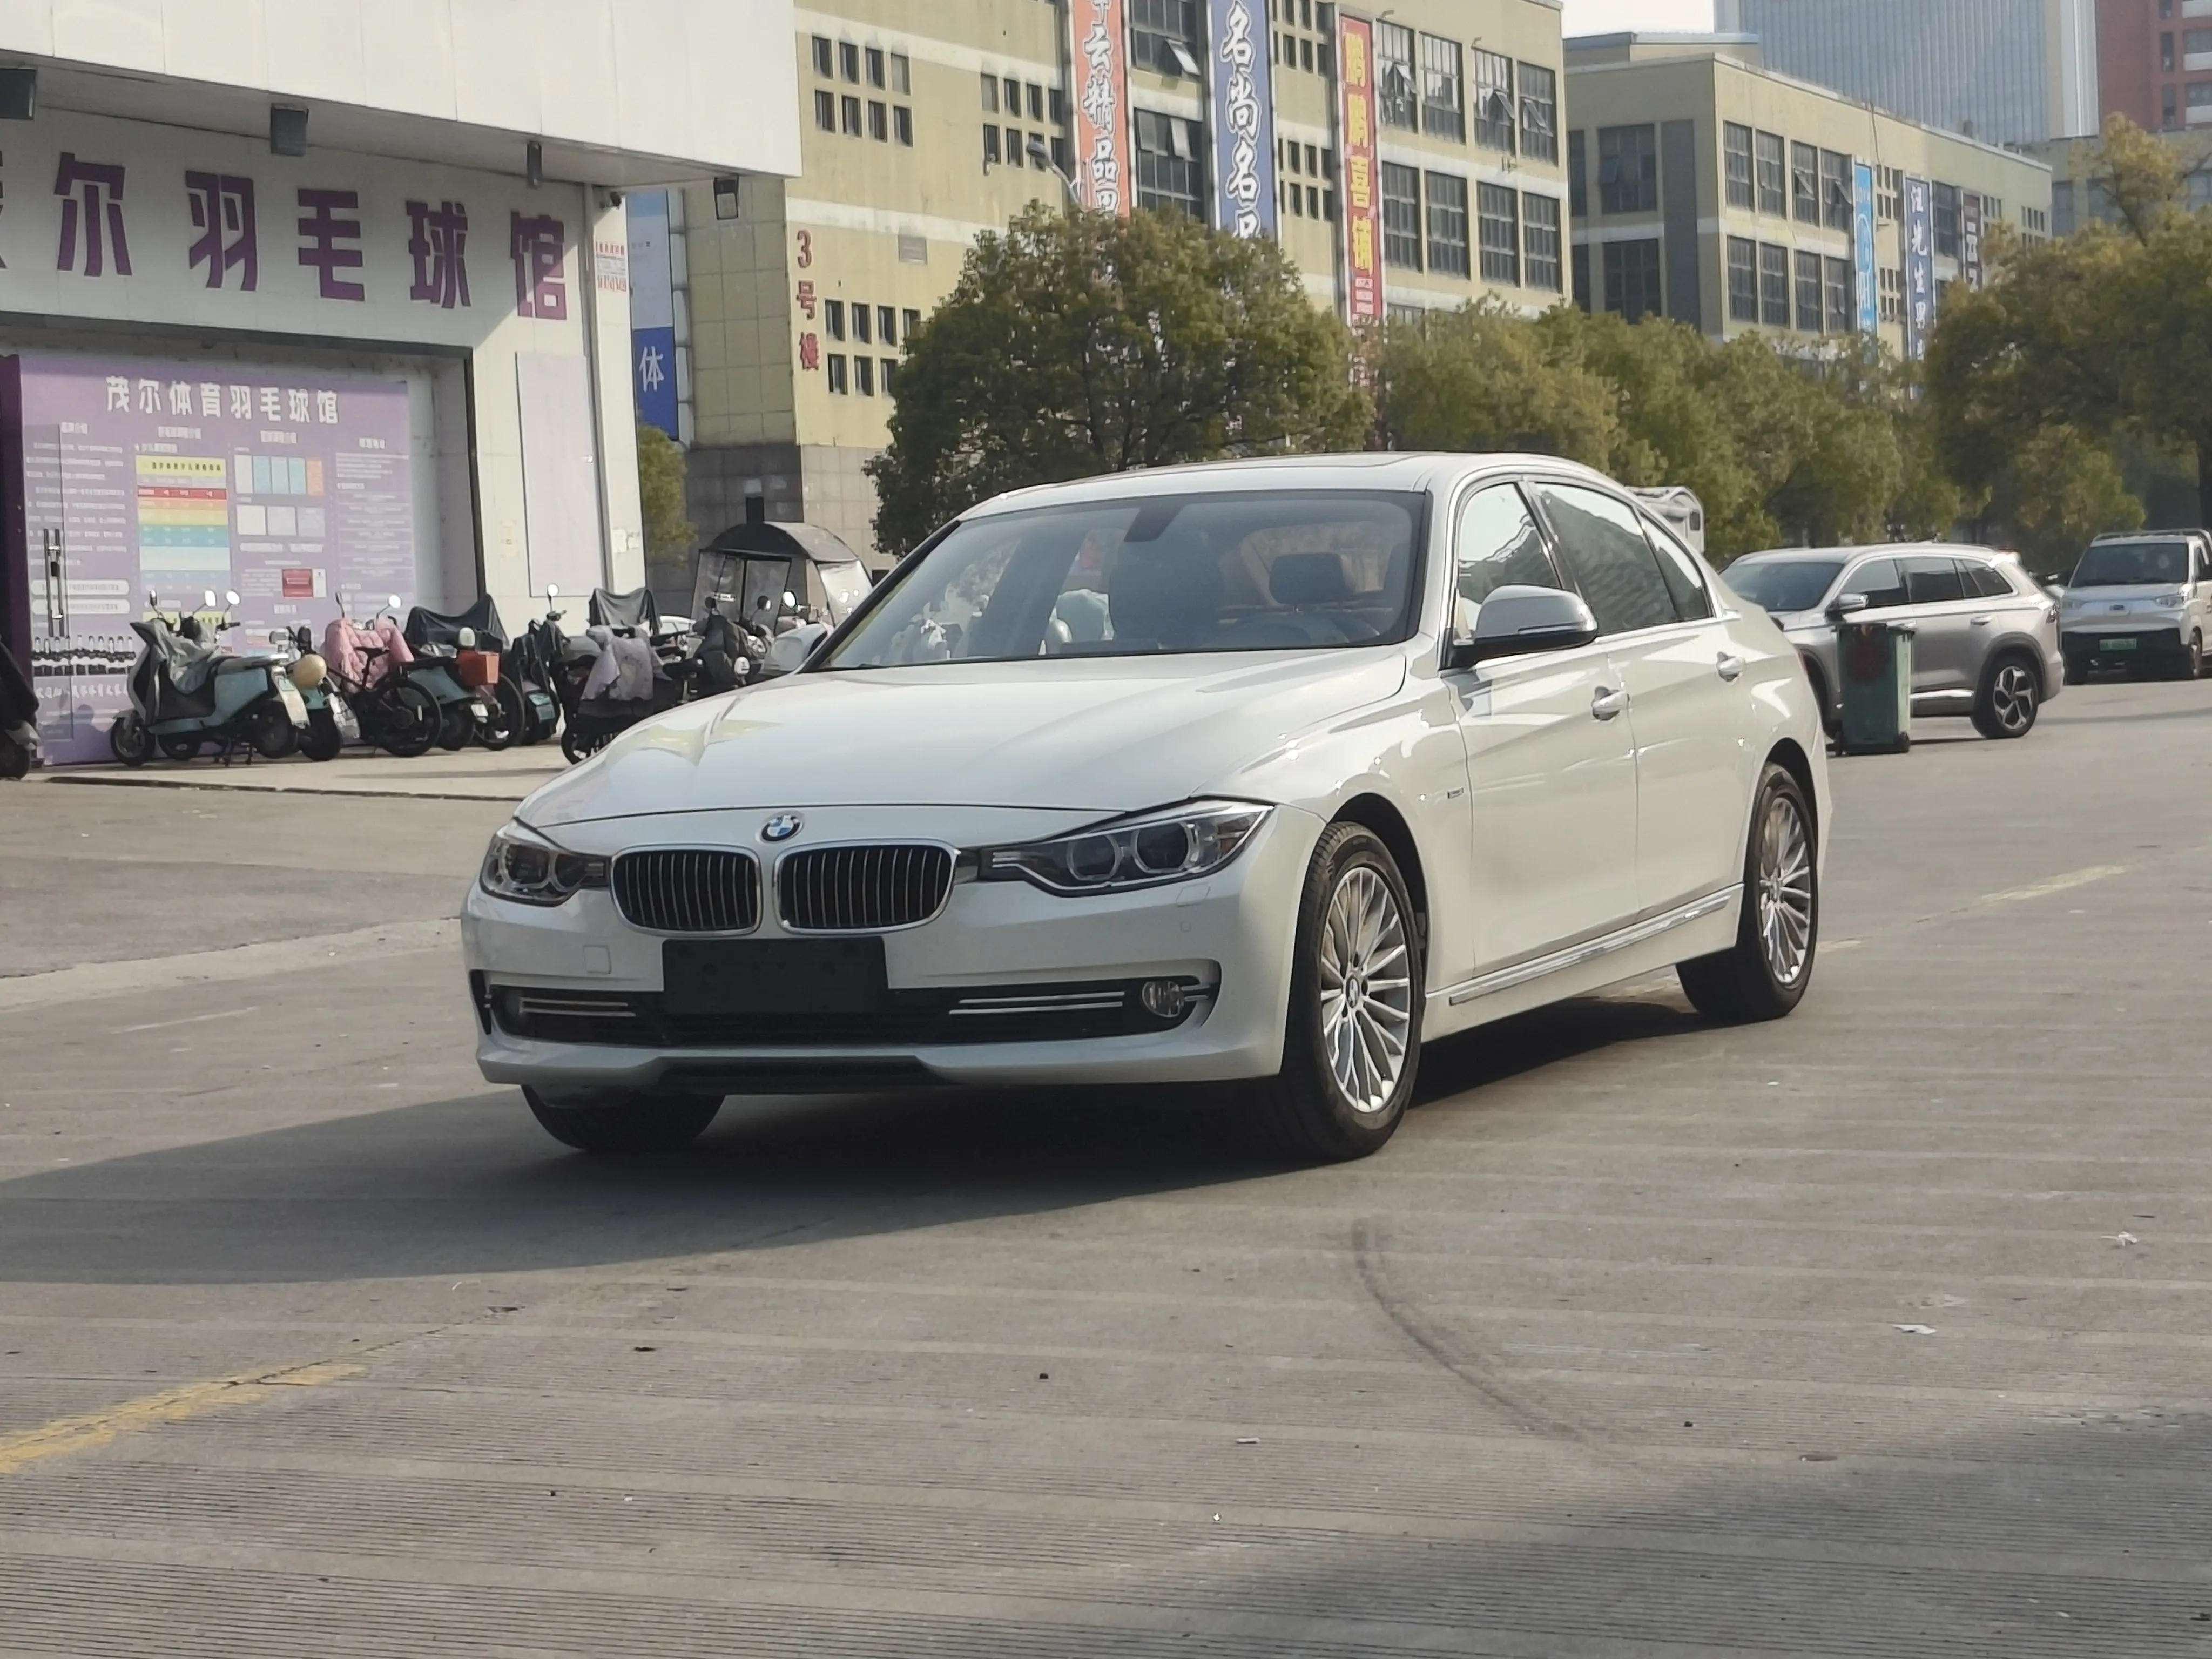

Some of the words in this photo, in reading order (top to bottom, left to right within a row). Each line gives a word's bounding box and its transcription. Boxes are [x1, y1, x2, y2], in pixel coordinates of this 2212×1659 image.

[0, 151, 568, 321] 尔羽毛球馆
[639, 346, 664, 393] 体
[105, 375, 339, 424] 茂尔体育羽毛球馆
